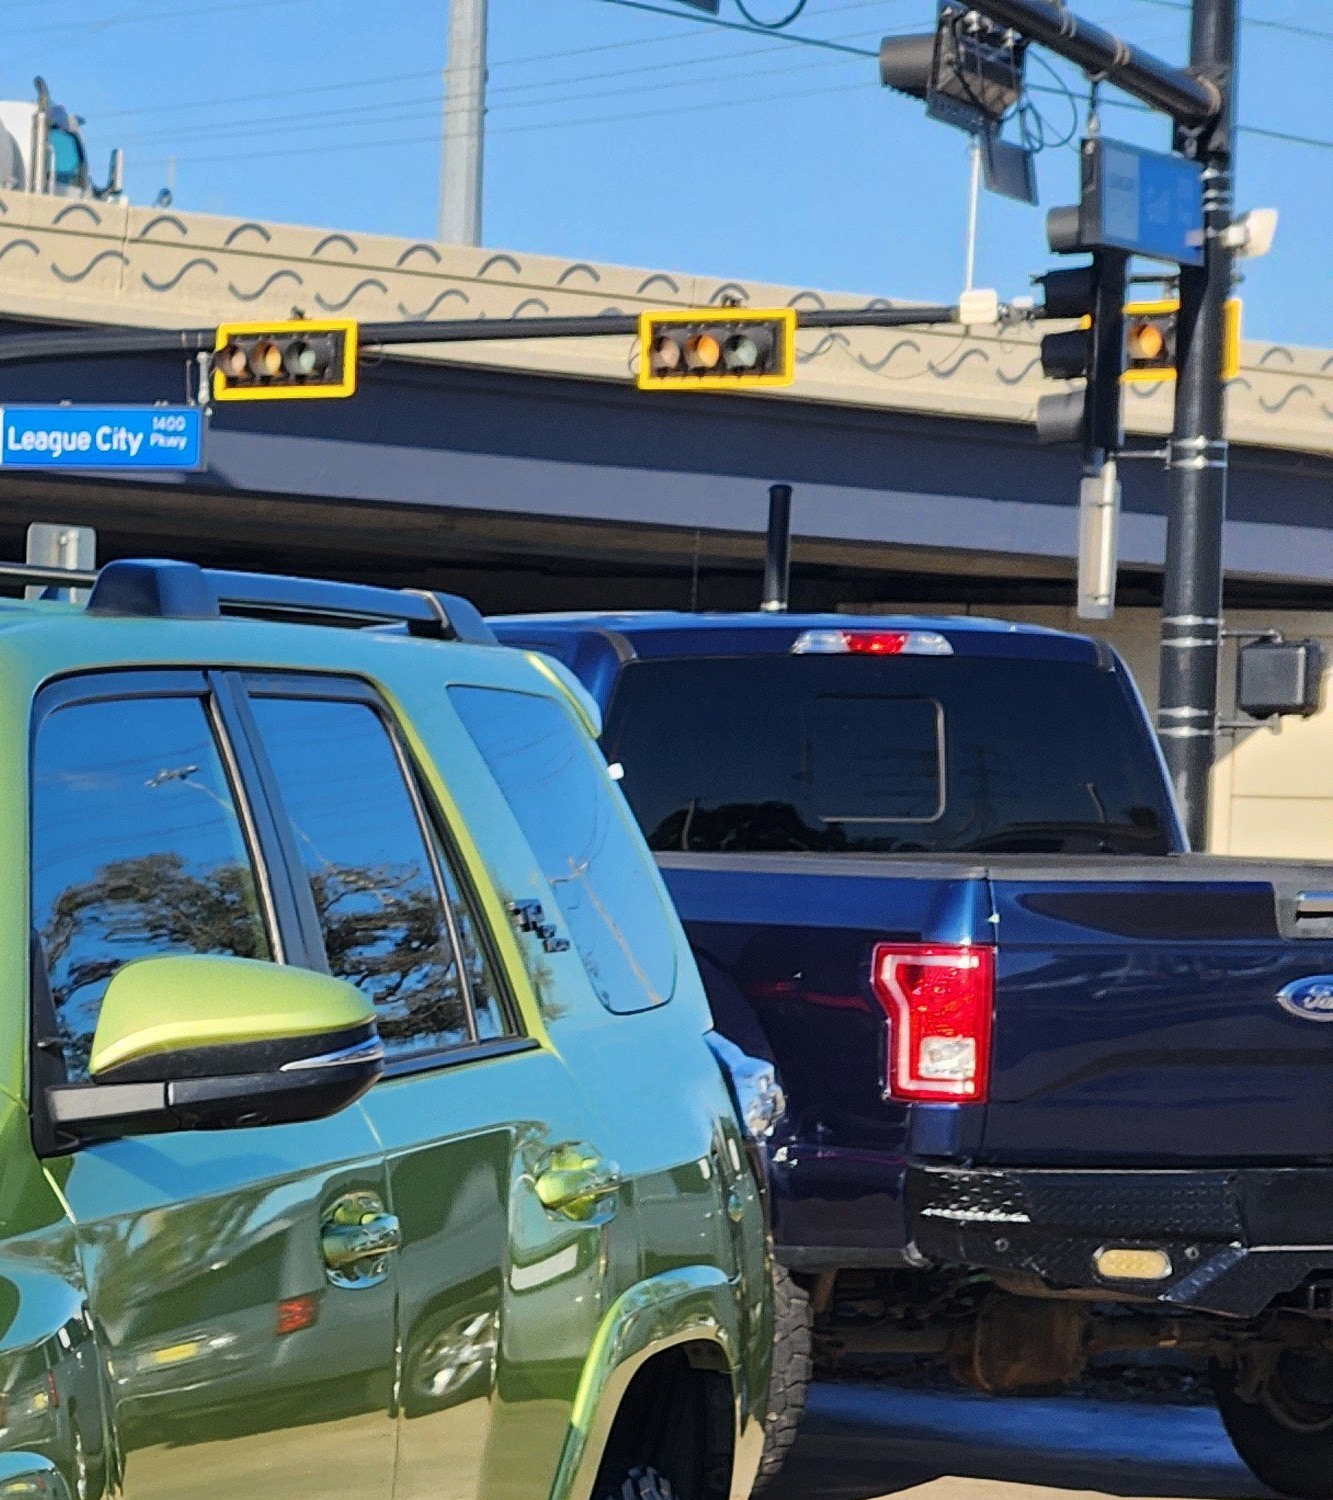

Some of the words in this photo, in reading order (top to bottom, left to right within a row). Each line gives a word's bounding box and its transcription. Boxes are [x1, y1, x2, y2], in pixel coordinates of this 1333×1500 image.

[152, 415, 187, 432] 1400
[7, 426, 93, 458] League
[95, 425, 144, 457] City
[149, 433, 188, 451] Pkwy
